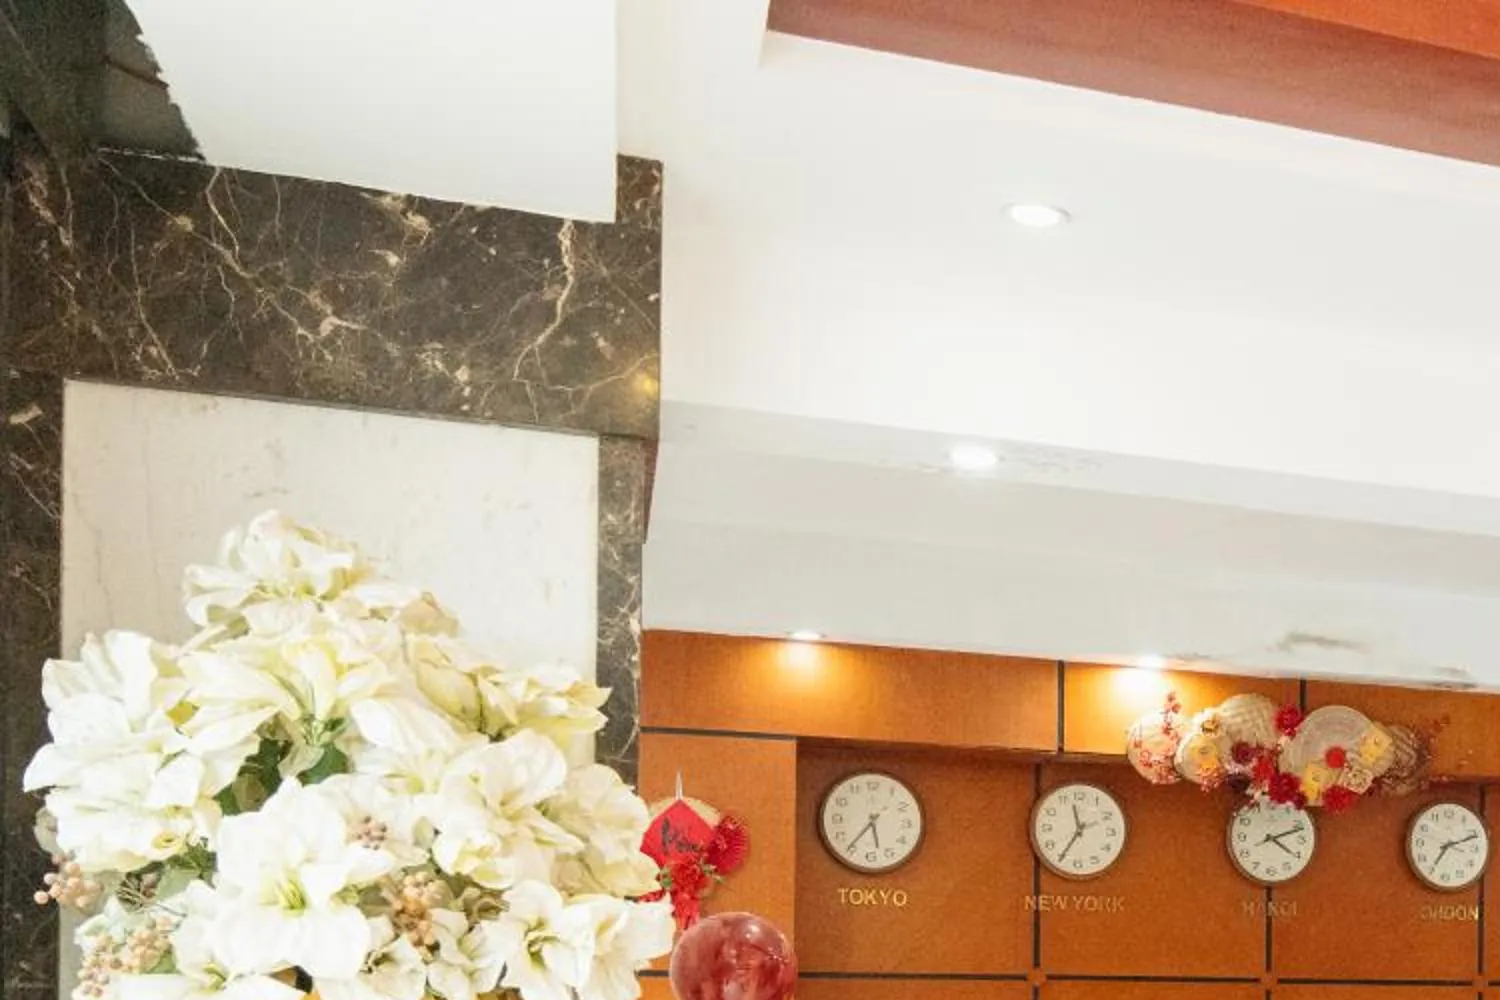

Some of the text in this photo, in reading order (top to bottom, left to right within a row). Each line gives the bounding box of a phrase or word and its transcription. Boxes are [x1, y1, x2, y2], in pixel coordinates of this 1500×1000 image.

[837, 887, 907, 907] TOKYO
[1024, 895, 1126, 913] NEW YORK
